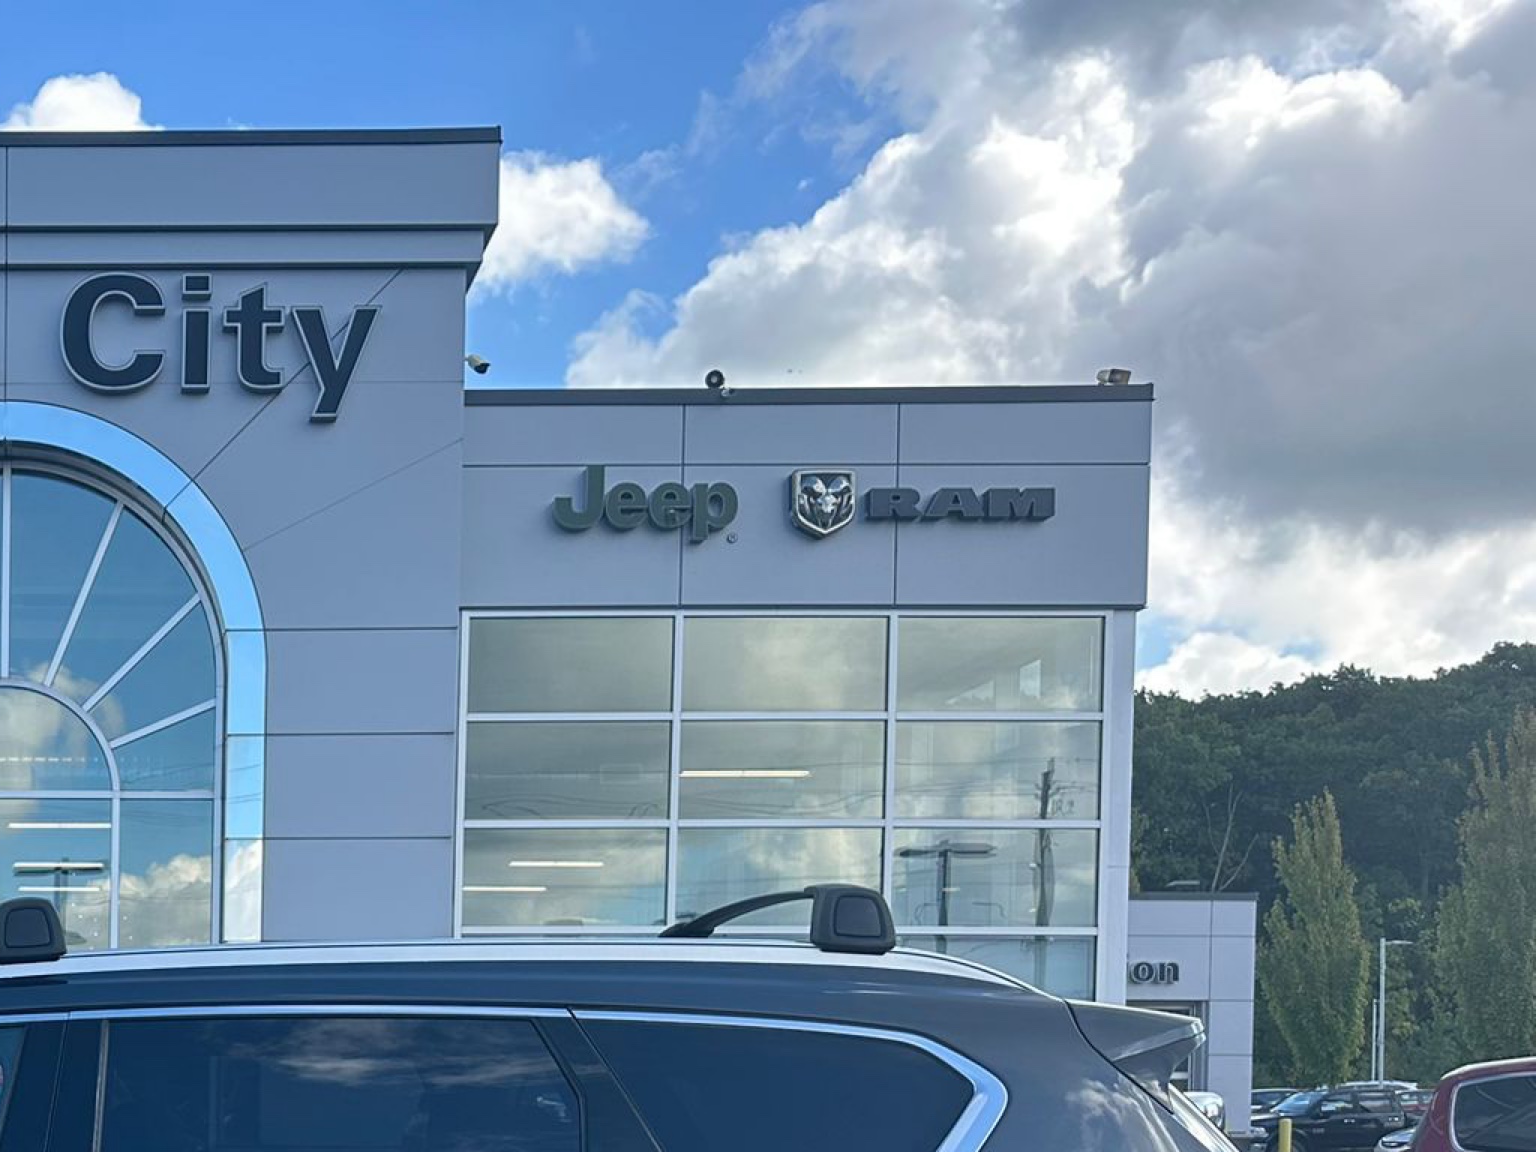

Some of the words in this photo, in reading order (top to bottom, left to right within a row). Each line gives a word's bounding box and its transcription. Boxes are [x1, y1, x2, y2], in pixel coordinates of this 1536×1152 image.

[59, 270, 382, 422] City
[552, 464, 739, 543] Jeep
[864, 487, 1056, 522] RAM
[1127, 953, 1180, 984] on
